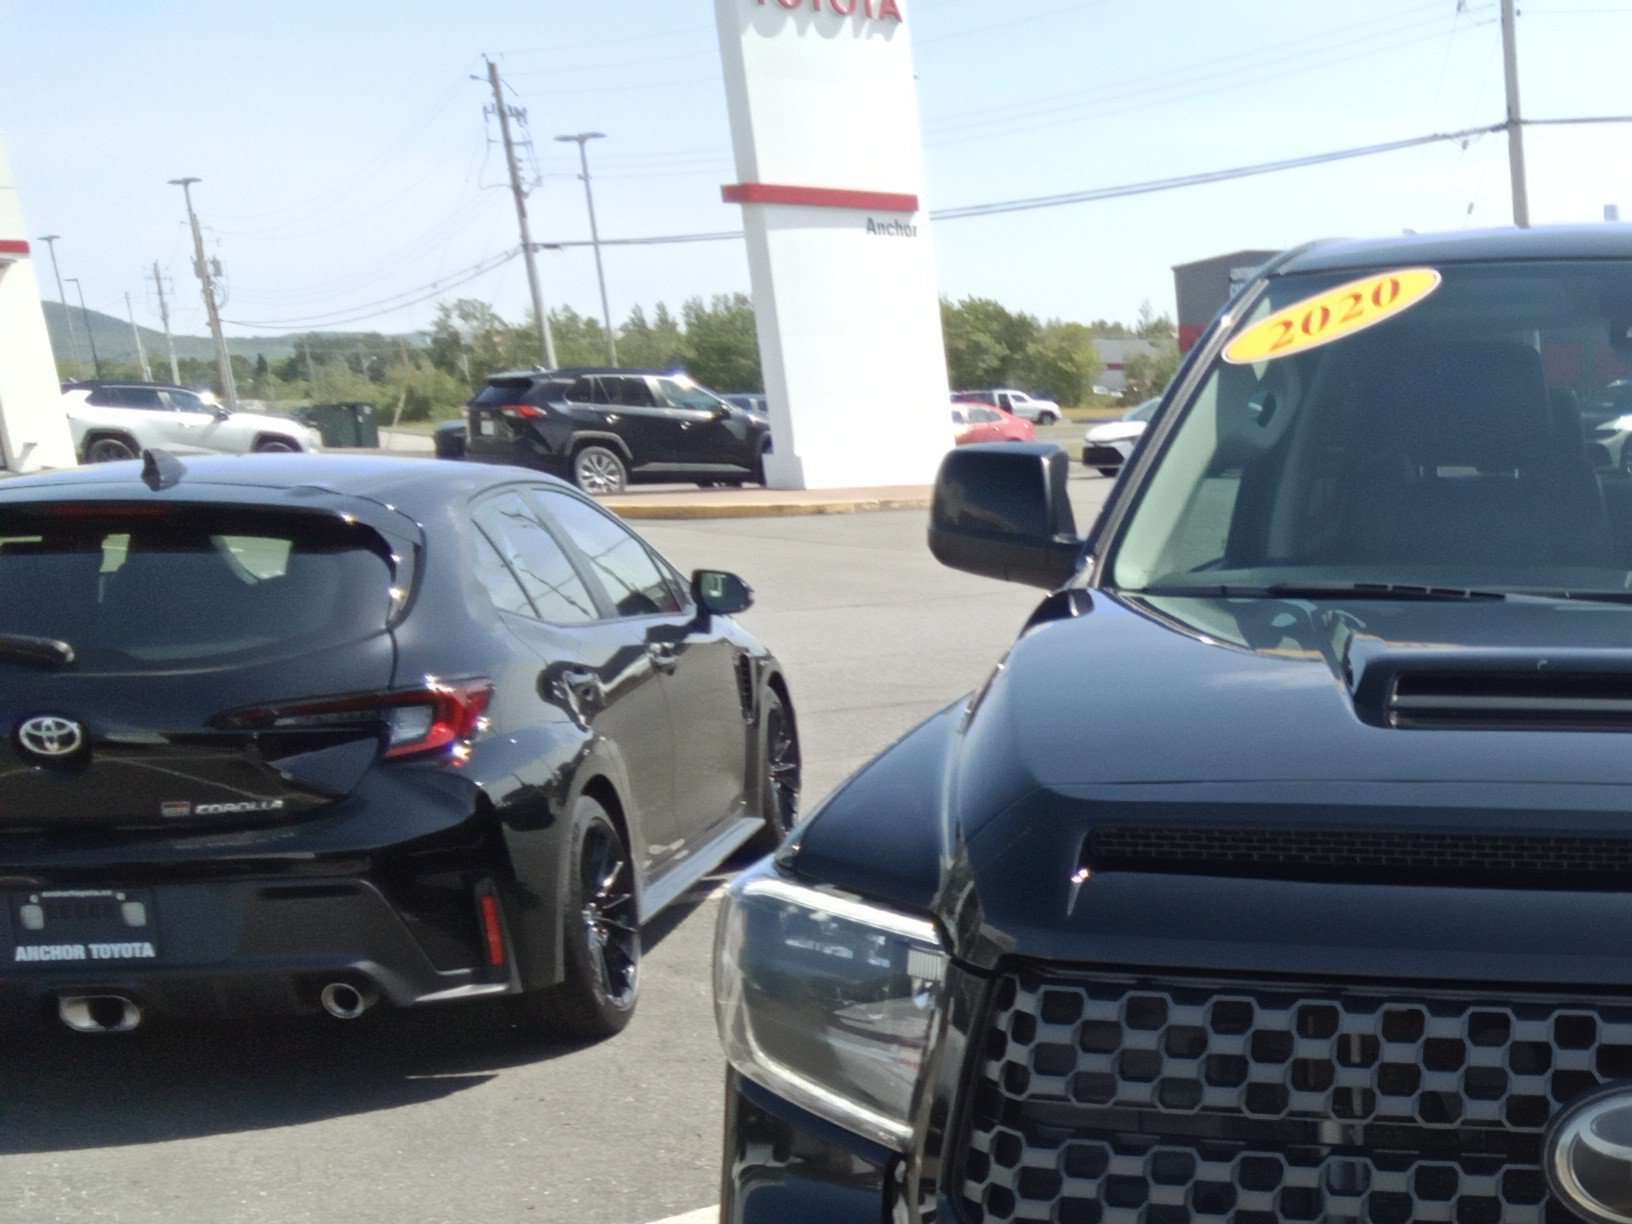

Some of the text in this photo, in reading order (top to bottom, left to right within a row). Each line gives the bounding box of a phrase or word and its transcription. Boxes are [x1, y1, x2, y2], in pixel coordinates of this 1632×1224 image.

[757, 0, 903, 23] OTA
[866, 217, 917, 238] Anchor
[1268, 278, 1400, 351] 2020
[15, 942, 156, 962] ANCHOR TOYOTA
